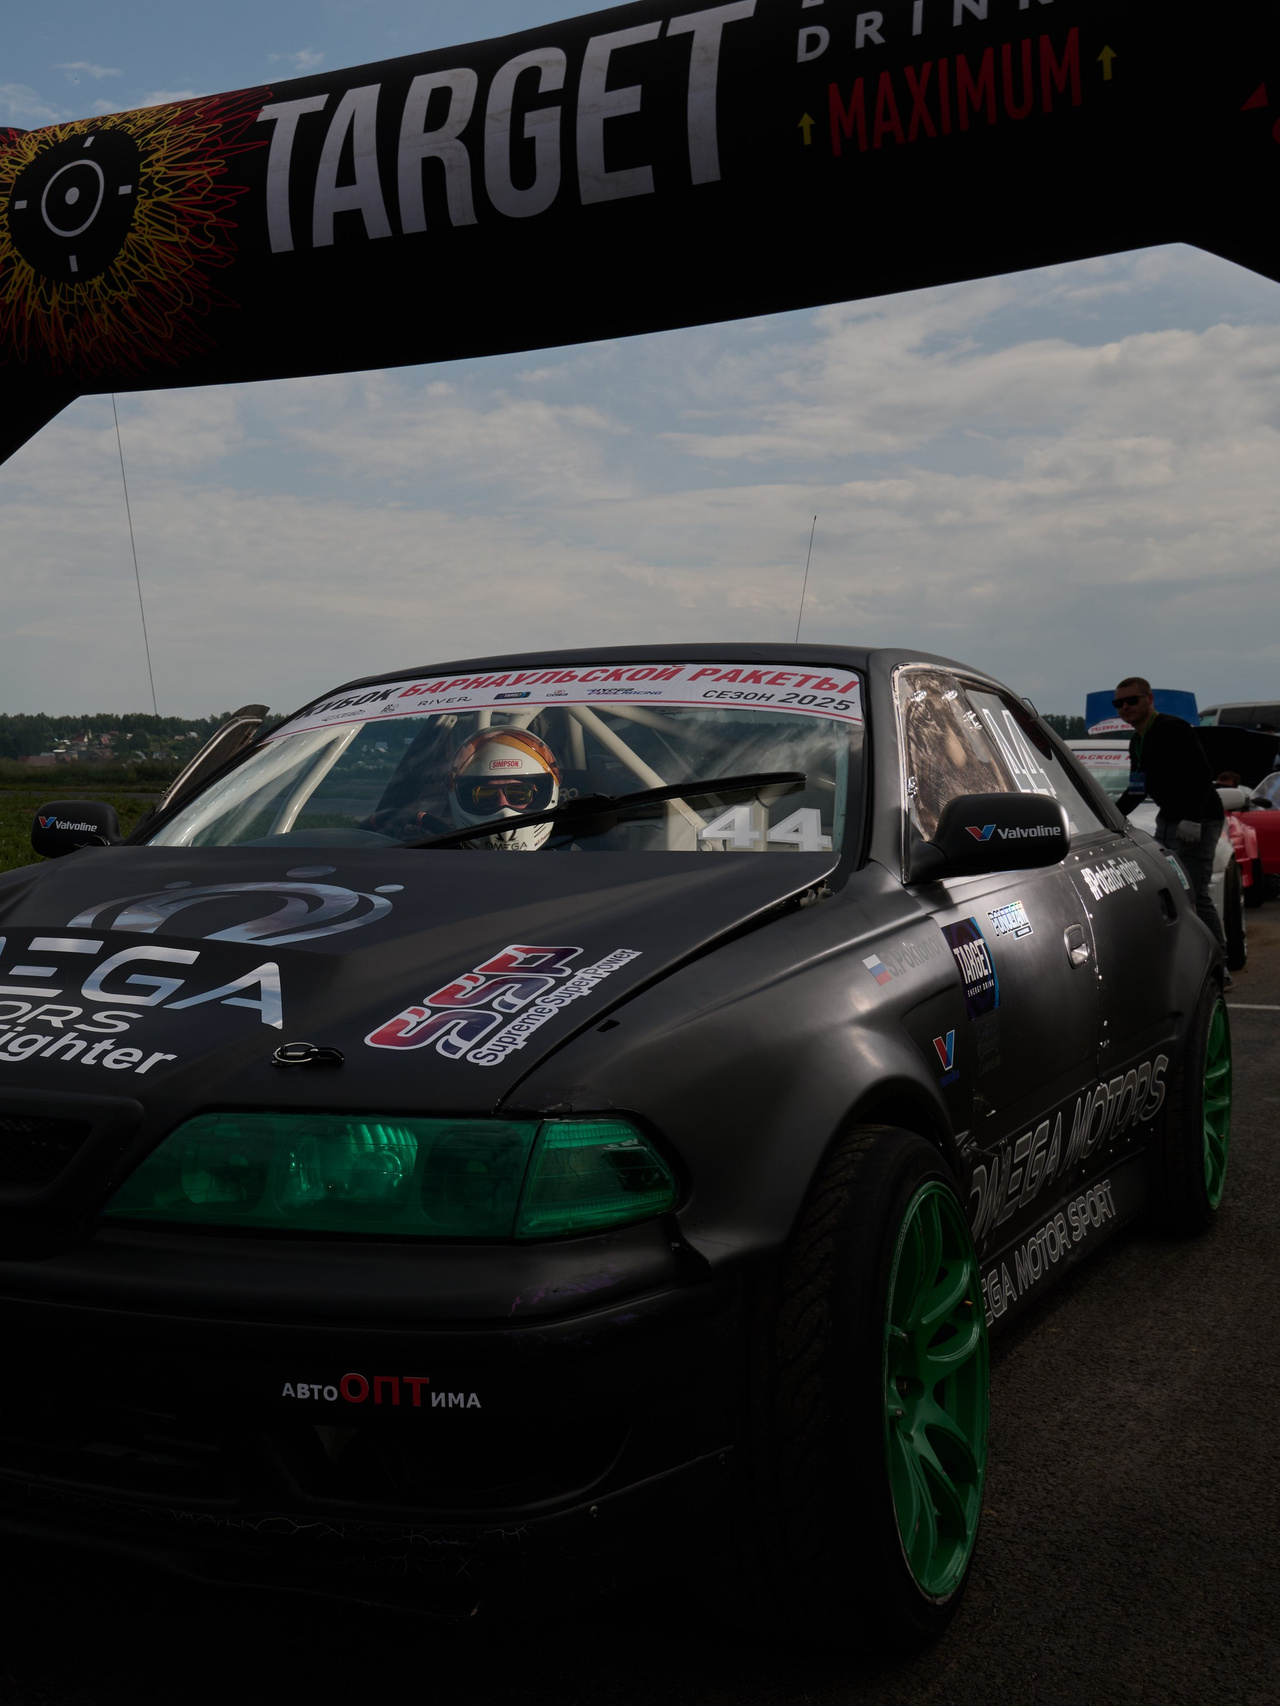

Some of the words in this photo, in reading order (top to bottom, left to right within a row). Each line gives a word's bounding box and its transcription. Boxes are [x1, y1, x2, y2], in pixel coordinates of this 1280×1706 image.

[796, 0, 1056, 64] DRIN
[827, 26, 1083, 158] MAXIMUM
[256, 1, 757, 254] TARGET
[398, 665, 689, 698] БАРНАУЛЬСКОЙ
[687, 667, 860, 695] РАКЕТЫ
[702, 689, 775, 702] СЕЗОН
[778, 692, 855, 711] 2025
[492, 760, 520, 768] SIMPSON
[55, 819, 98, 833] Valvoline
[485, 841, 528, 851] OMEGA
[699, 805, 833, 851] 44
[997, 825, 1062, 840] Valvoline
[953, 938, 993, 985] TARGET
[471, 1004, 553, 1063] Supreme
[542, 976, 595, 1006] Super
[584, 949, 636, 977] Power
[967, 984, 983, 998] ENERGY
[982, 979, 995, 992] DRINK
[1057, 1054, 1169, 1178] MOTORS
[980, 1262, 1018, 1328] EGA
[1015, 1212, 1072, 1295] MOTOR
[1067, 1178, 1116, 1242] SPORT
